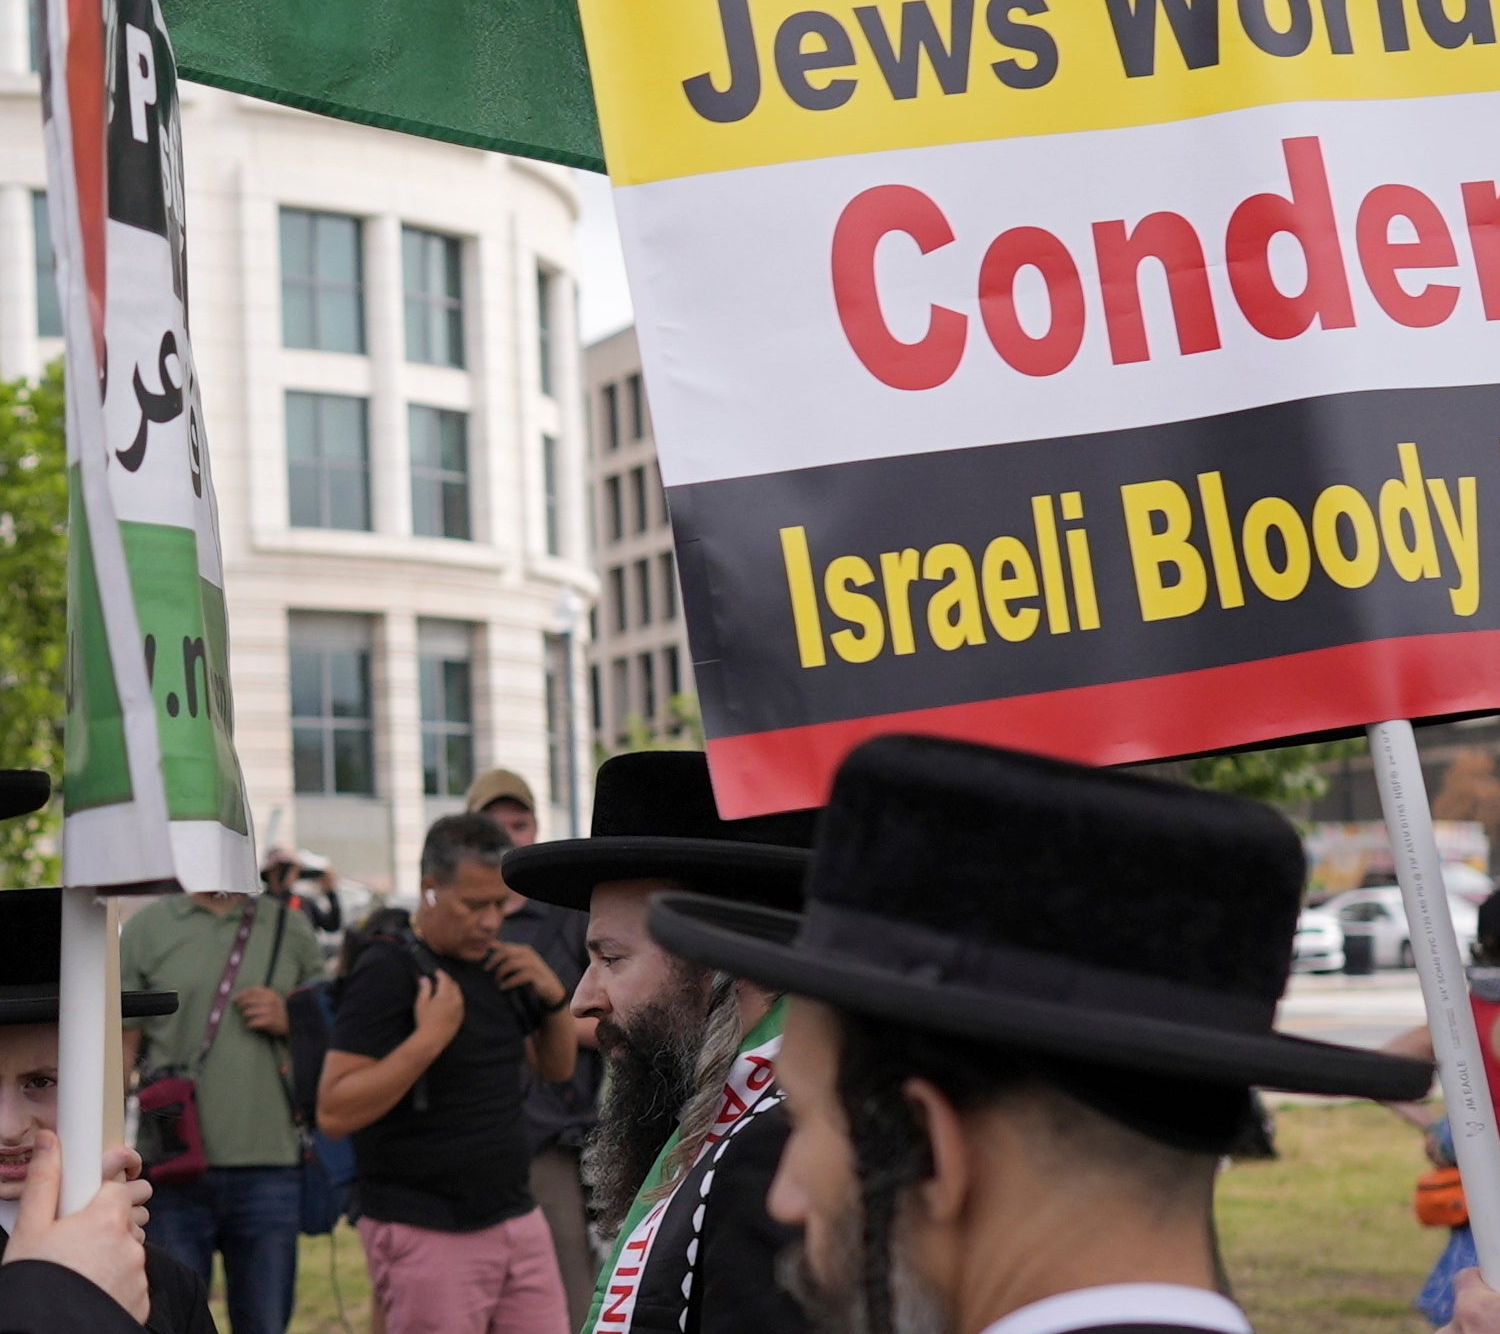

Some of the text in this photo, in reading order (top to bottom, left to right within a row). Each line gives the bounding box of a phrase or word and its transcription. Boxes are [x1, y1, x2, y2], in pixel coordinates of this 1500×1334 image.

[779, 492, 1102, 669] Israeli
[1119, 443, 1481, 623] Bloody
[1457, 1060, 1473, 1095] EAGLE
